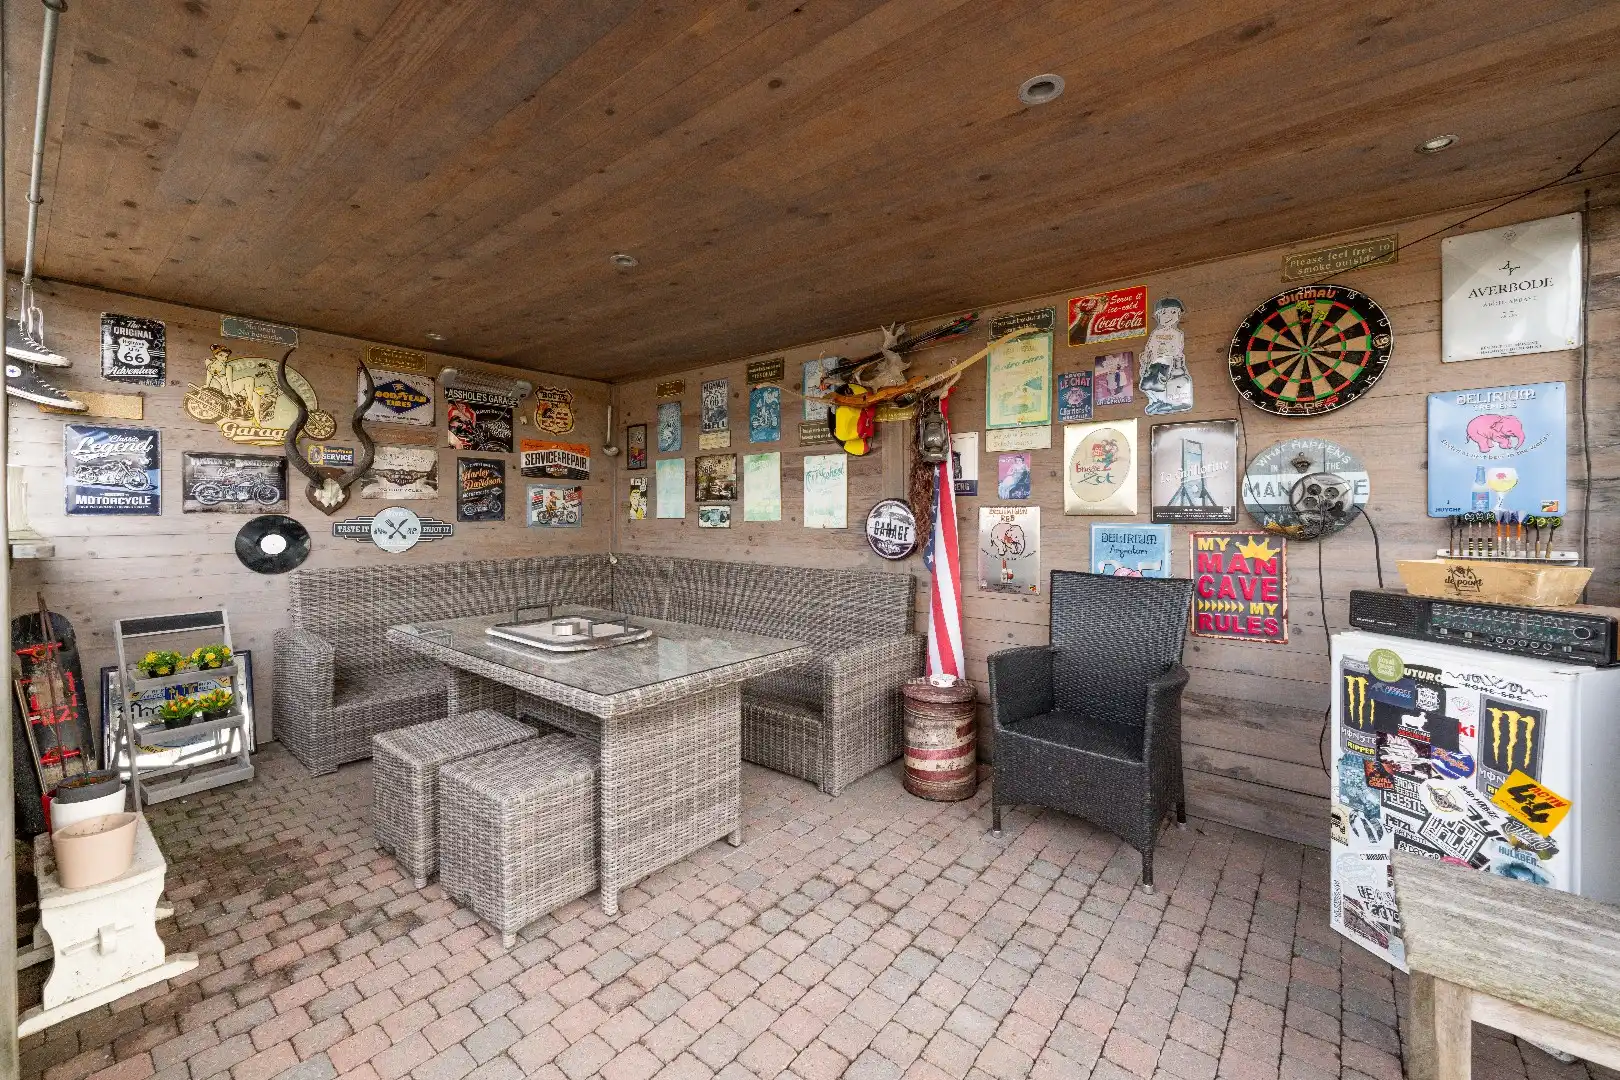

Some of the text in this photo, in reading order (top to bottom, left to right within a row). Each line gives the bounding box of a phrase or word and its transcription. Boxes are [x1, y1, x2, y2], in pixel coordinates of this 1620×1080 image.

[1290, 257, 1324, 268] Please
[1328, 250, 1348, 261] feel
[1353, 245, 1374, 256] free
[1298, 262, 1332, 275] smoke
[1468, 277, 1554, 299] AVERBODE
[113, 326, 154, 340] ORIGINAL
[124, 351, 145, 364] 66
[107, 366, 159, 376] Adventure
[1070, 378, 1091, 387] CHAT
[541, 391, 567, 401] ROUTE
[1457, 388, 1537, 405] DELIRIUM
[71, 436, 153, 458] Legend
[1256, 440, 1352, 467] WHAT HAPPENS
[321, 453, 353, 462] SERVICE
[525, 450, 558, 466] SERVICE
[561, 453, 587, 470] REPAIR
[1325, 462, 1341, 470] THE
[75, 495, 152, 505] MOTORCYCLE
[337, 525, 361, 533] TASTE
[874, 520, 910, 542] GARAGE
[1101, 533, 1157, 545] DELIRIUM
[1197, 537, 1231, 552] MY
[1197, 552, 1278, 575] MAN
[1197, 574, 1279, 602] CAVE
[1249, 602, 1279, 616] MY
[1197, 612, 1279, 636] RULES
[1404, 667, 1442, 683] UTURO
[1342, 727, 1377, 745] MONSTE
[1347, 740, 1375, 755] RIPPER
